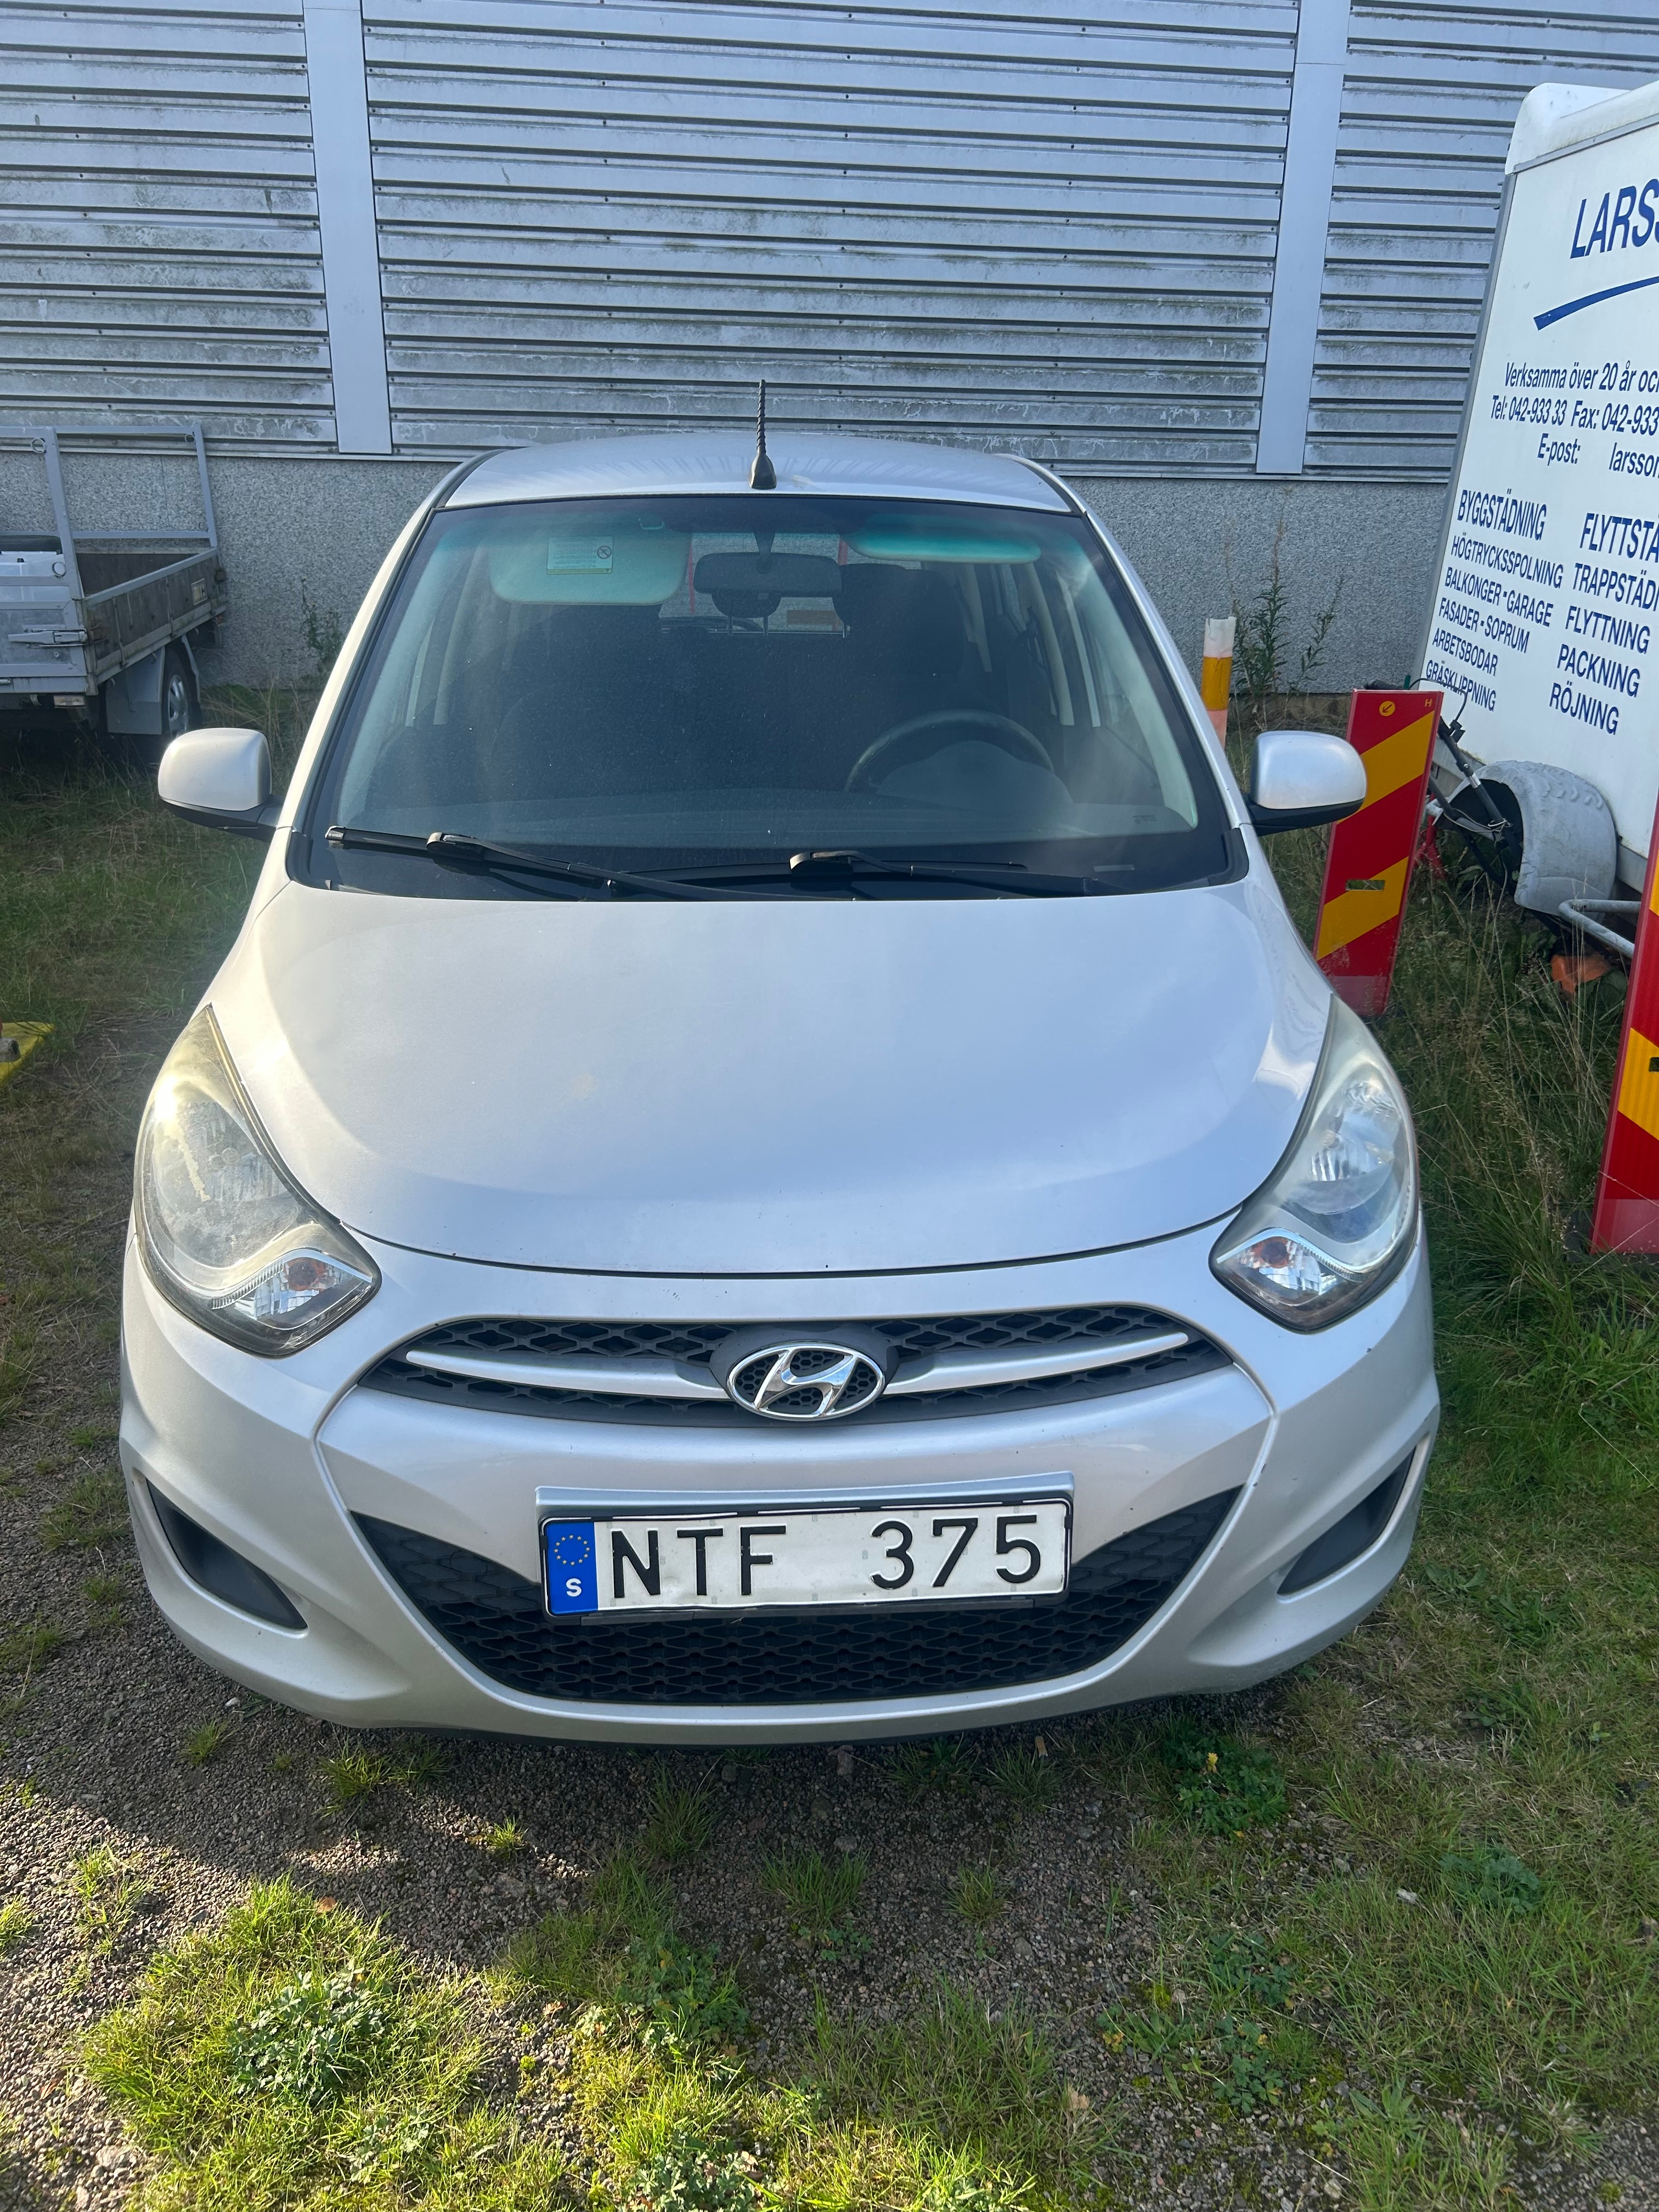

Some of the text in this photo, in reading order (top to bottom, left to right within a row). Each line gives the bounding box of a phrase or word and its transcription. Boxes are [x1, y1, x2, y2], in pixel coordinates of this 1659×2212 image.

[1570, 178, 1659, 259] LARS
[1505, 360, 1659, 393] Verksamma över 20 år oc
[1491, 395, 1659, 436] Tel: 042-933 33 Fax: 042-933
[1537, 433, 1581, 466] E-post:
[1457, 488, 1547, 541] BYGGSTÄDNING
[1451, 532, 1564, 589] HÖGTRYCKSSPOLNING
[1432, 628, 1498, 676] ARBETSBODAR
[1565, 605, 1650, 654] FLYTTNING
[1426, 659, 1497, 712] GRÄSKLIPPNING
[1557, 644, 1640, 698] PACKNING
[1424, 698, 1433, 707] H
[1549, 680, 1619, 735] RÖJNING
[611, 1514, 1041, 1599] NTF 375
[566, 1578, 583, 1597] S
